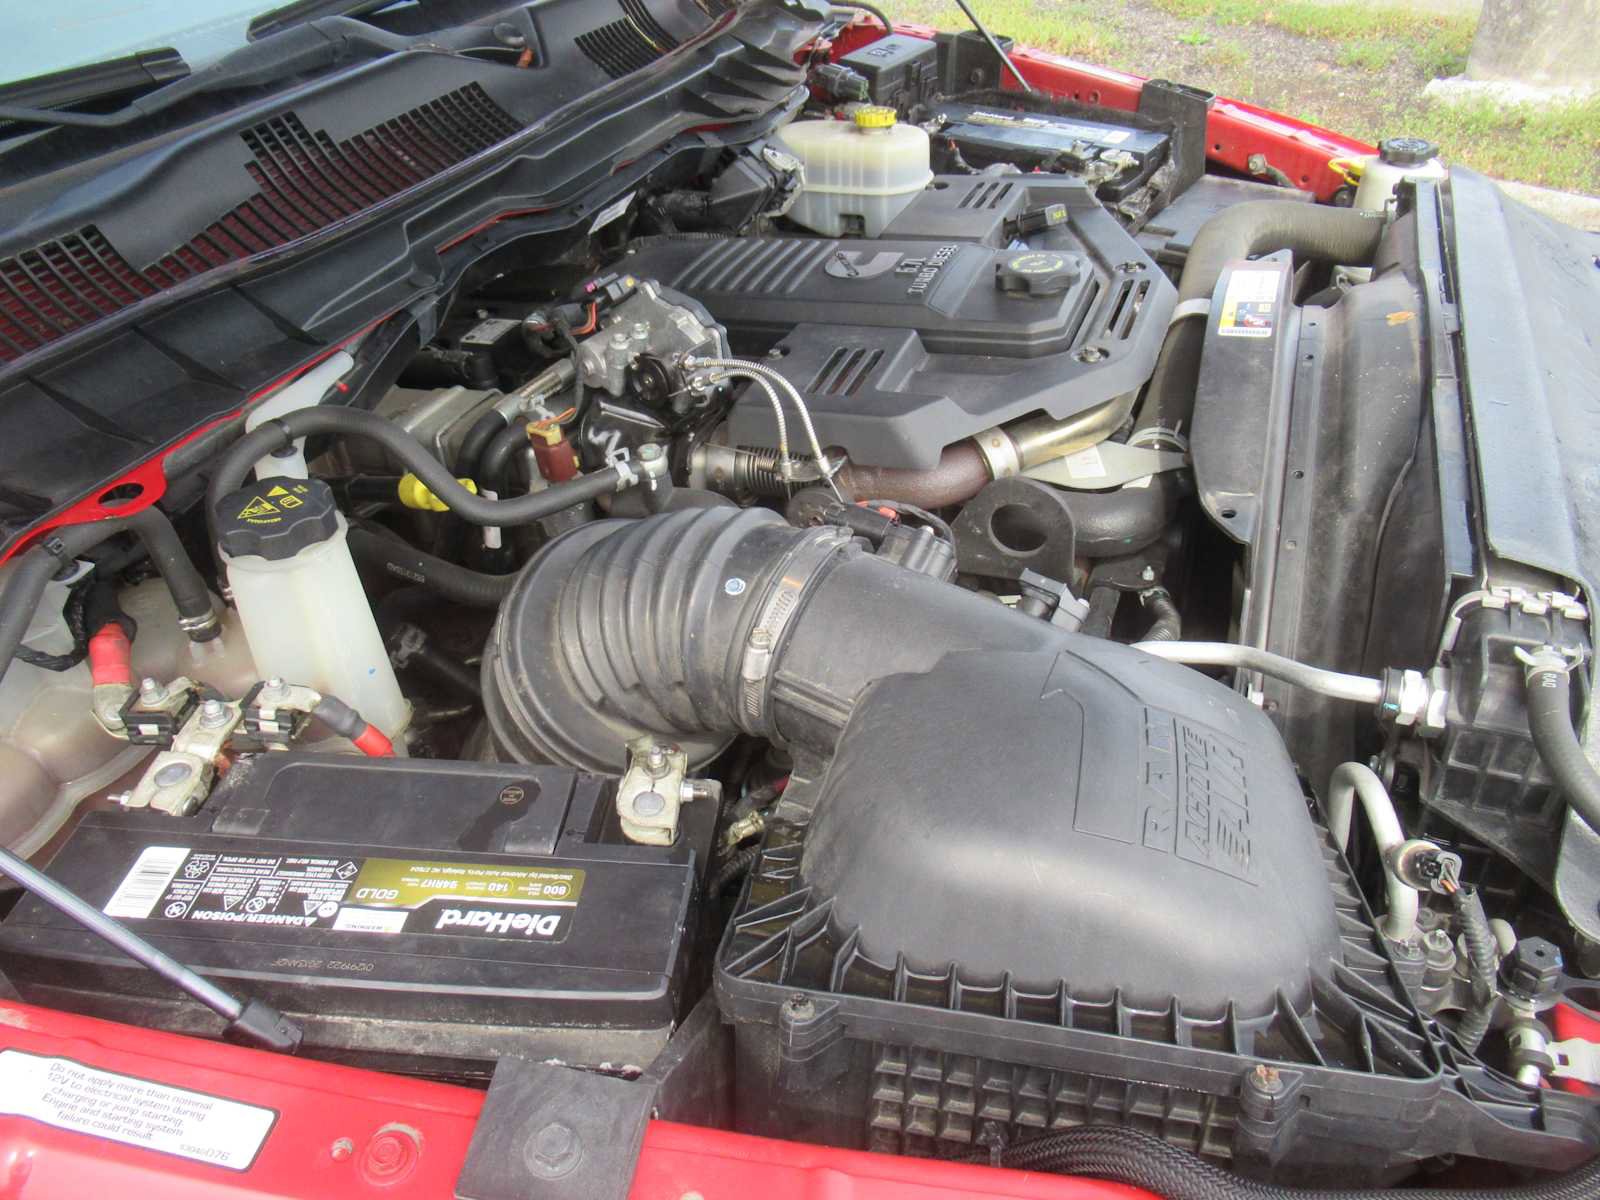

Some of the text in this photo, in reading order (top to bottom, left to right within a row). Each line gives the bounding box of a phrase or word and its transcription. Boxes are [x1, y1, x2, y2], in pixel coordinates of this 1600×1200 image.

[907, 244, 958, 294] TURBO DIESEL
[1142, 706, 1172, 854] RAM
[1182, 724, 1211, 860] ACTIVE
[356, 887, 400, 900] GOLD
[488, 882, 509, 892] 140
[544, 885, 567, 896] 800
[191, 910, 305, 926] DANGER/POISON
[435, 909, 561, 936] DieHard
[50, 1061, 65, 1073] Do
[67, 1069, 86, 1081] not
[87, 1076, 115, 1089] apply
[115, 1083, 144, 1095] more
[146, 1088, 170, 1101] than
[47, 1071, 206, 1122] 12V to electrical system during
[51, 1086, 98, 1107] charging
[99, 1100, 112, 1108] or
[111, 1104, 139, 1116] jump
[41, 1092, 184, 1136] Engine and starting system
[56, 1109, 91, 1126] failure
[91, 1119, 121, 1133] could
